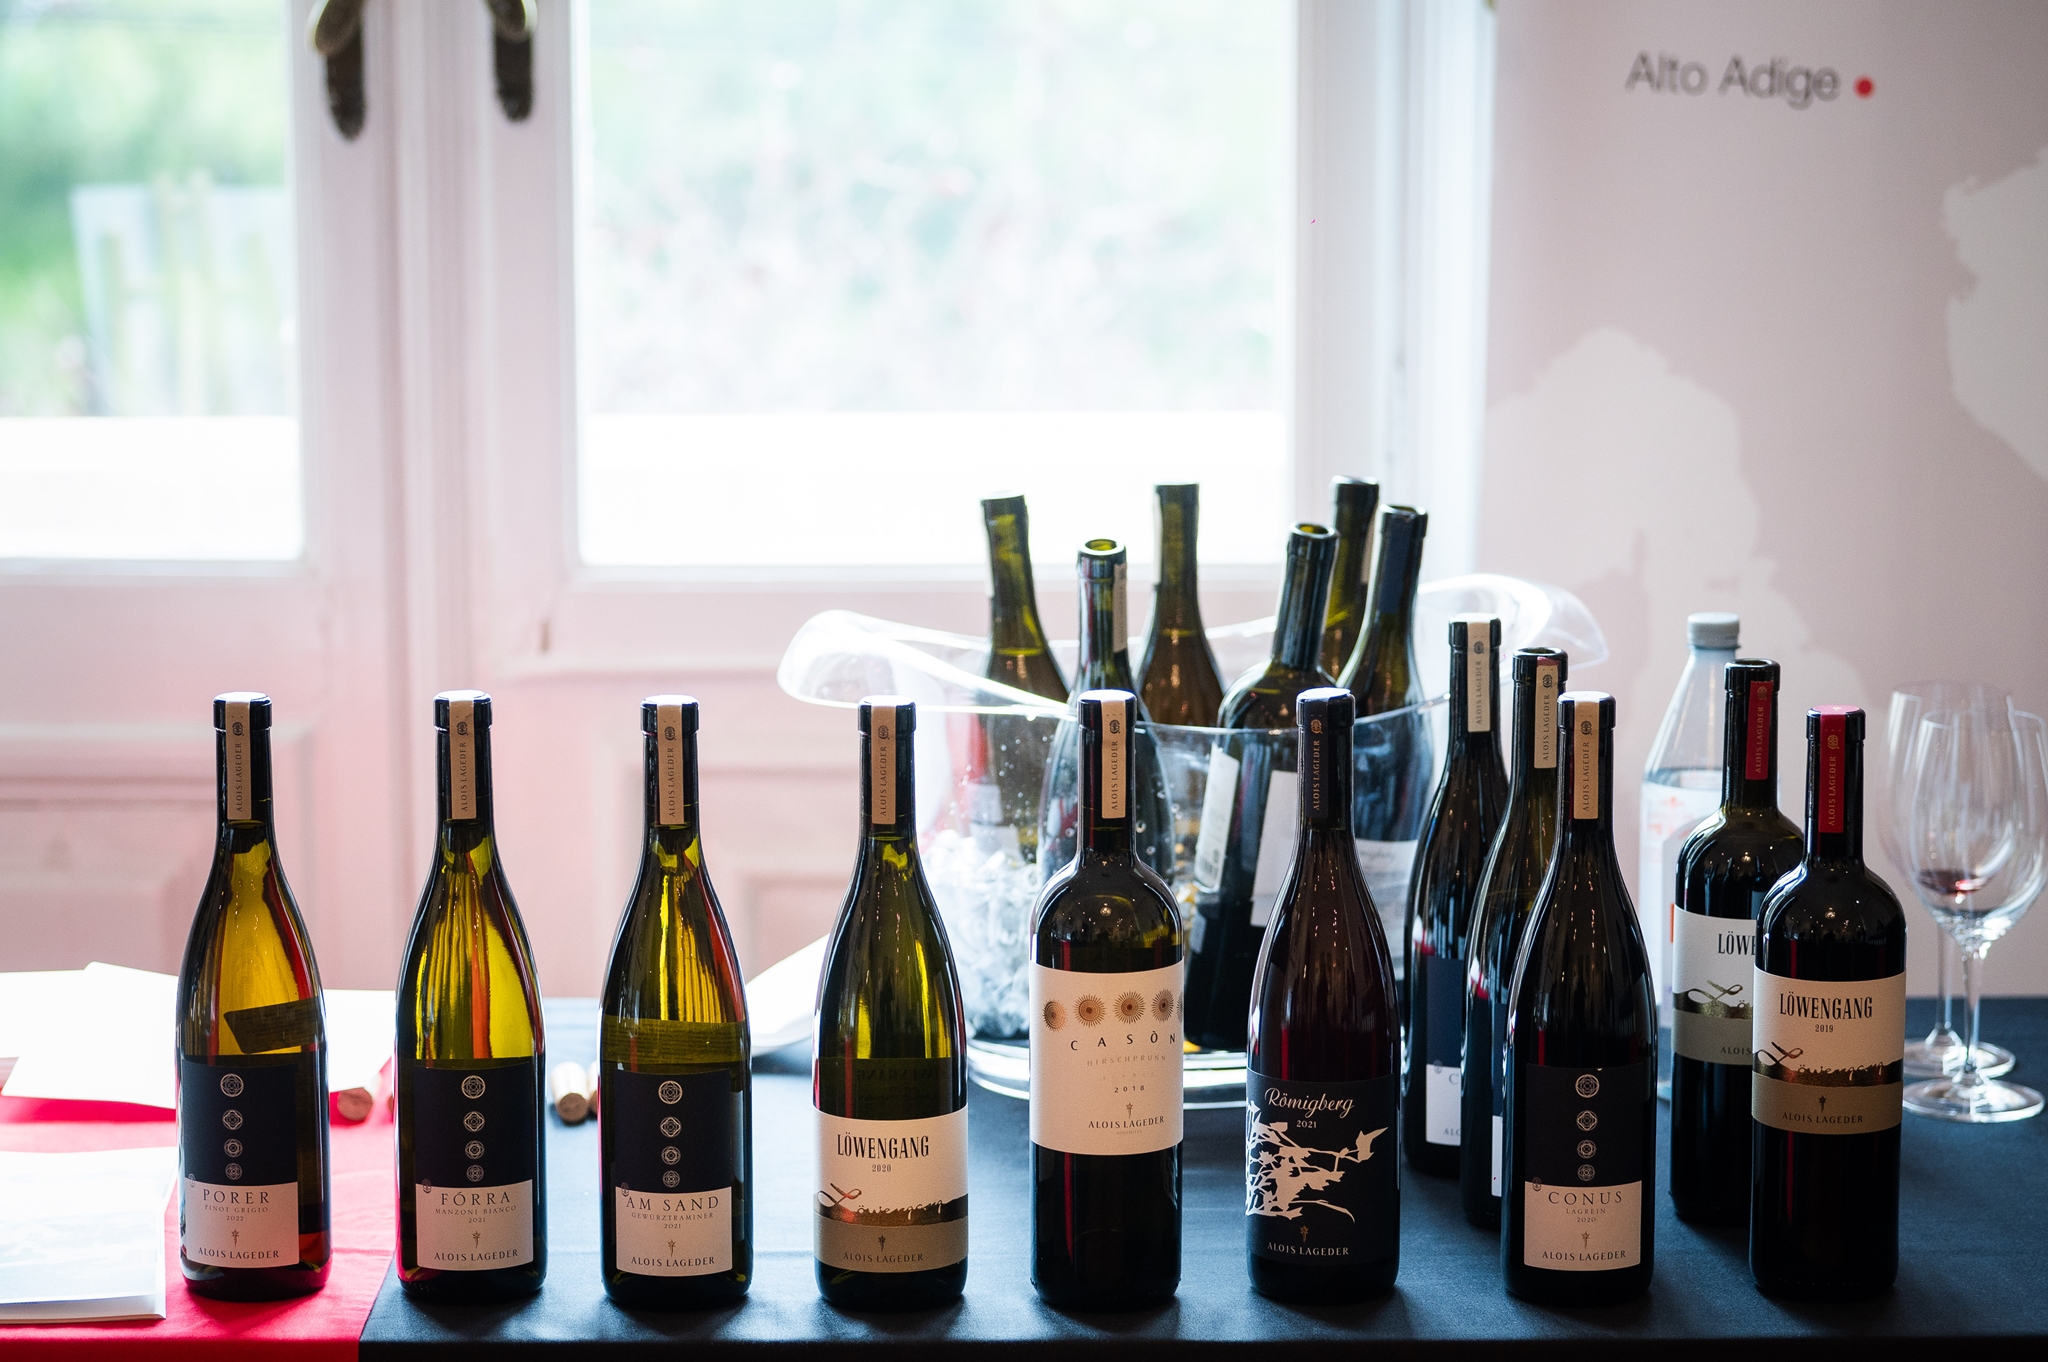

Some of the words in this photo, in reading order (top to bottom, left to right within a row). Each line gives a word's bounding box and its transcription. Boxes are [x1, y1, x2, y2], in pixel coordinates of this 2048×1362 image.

[1625, 52, 1709, 96] Alto
[1718, 54, 1841, 111] Adige
[1756, 706, 1764, 745] LAGEDER
[667, 747, 675, 788] LAGEDER
[1582, 741, 1590, 782] LAGEDER
[1829, 755, 1837, 797] LAGEDER
[1828, 798, 1836, 826] ALOIS
[1779, 991, 1873, 1020] LÖWENGANG
[1815, 1024, 1834, 1033] 2019
[1114, 1085, 1145, 1093] 2018
[1264, 1087, 1354, 1119] Römigberg
[1088, 1120, 1120, 1129] ALOIS
[1123, 1115, 1164, 1128] LAGEDER
[1296, 1120, 1317, 1129] 2021
[1782, 1111, 1812, 1123] ALOIS
[1816, 1114, 1863, 1124] LAGEDER
[837, 1131, 930, 1159] LÖWENGANG
[871, 1164, 892, 1172] 2020
[203, 1189, 270, 1205] PORER
[441, 1191, 510, 1206] FÓRRA
[626, 1196, 651, 1210] AM
[663, 1196, 719, 1211] SAND
[1548, 1190, 1622, 1206] CONUS
[204, 1204, 230, 1213] PINOT
[483, 1205, 517, 1215] BIANCO
[198, 1247, 227, 1259] ALOIS
[229, 1249, 280, 1260] LAGEDER
[434, 1252, 467, 1261] ALOIS
[471, 1249, 519, 1261] LAGEDER
[1267, 1242, 1296, 1254] ALOIS
[1299, 1247, 1349, 1256] LAGEDER
[1542, 1250, 1575, 1261] ALOIS
[1579, 1250, 1626, 1261] LAGEDER
[631, 1256, 662, 1267] ALOIS
[666, 1256, 715, 1267] LAGEDER
[843, 1252, 873, 1262] ALOIS
[876, 1253, 924, 1263] LAGEDER
